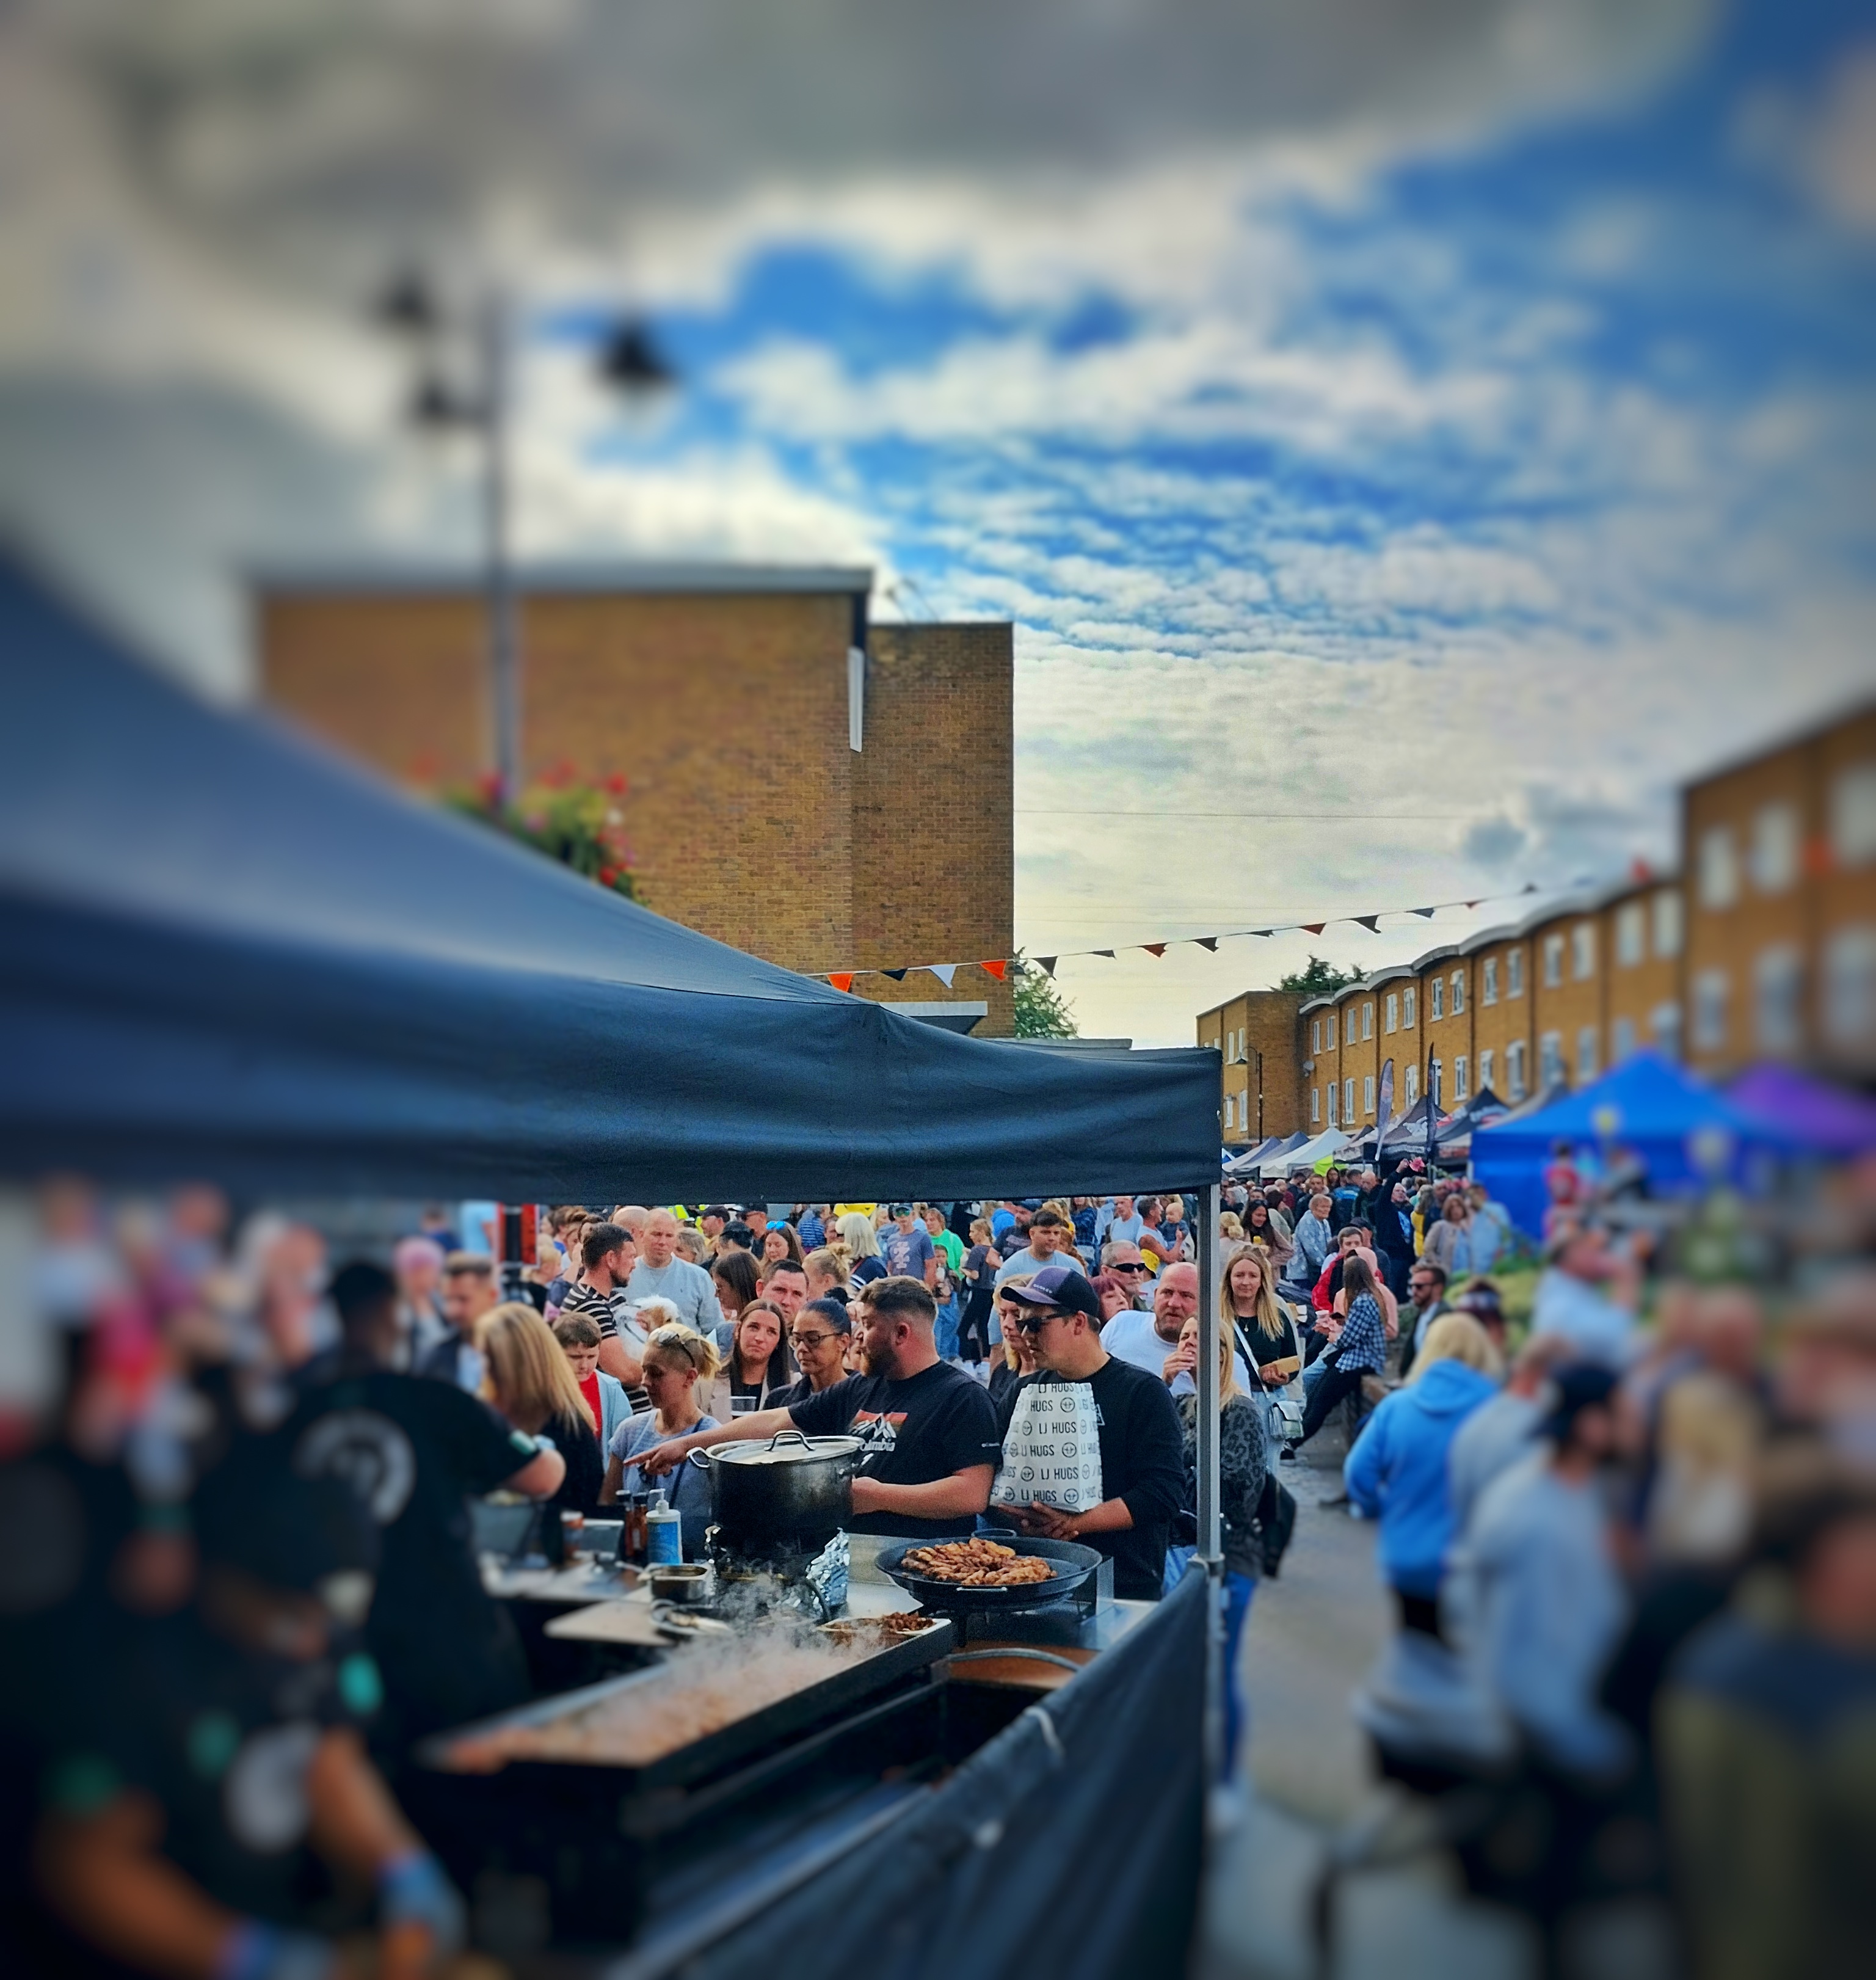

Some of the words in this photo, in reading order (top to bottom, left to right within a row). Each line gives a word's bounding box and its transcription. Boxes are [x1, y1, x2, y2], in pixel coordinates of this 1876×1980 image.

[1052, 1383, 1074, 1392] HUGS
[1030, 1399, 1053, 1412] HUGS
[1052, 1421, 1076, 1433] HUGS
[860, 1438, 895, 1452] olumbia
[1030, 1444, 1055, 1457] HUGS
[1054, 1467, 1078, 1480] HUGS
[1033, 1490, 1056, 1502] HUGS
